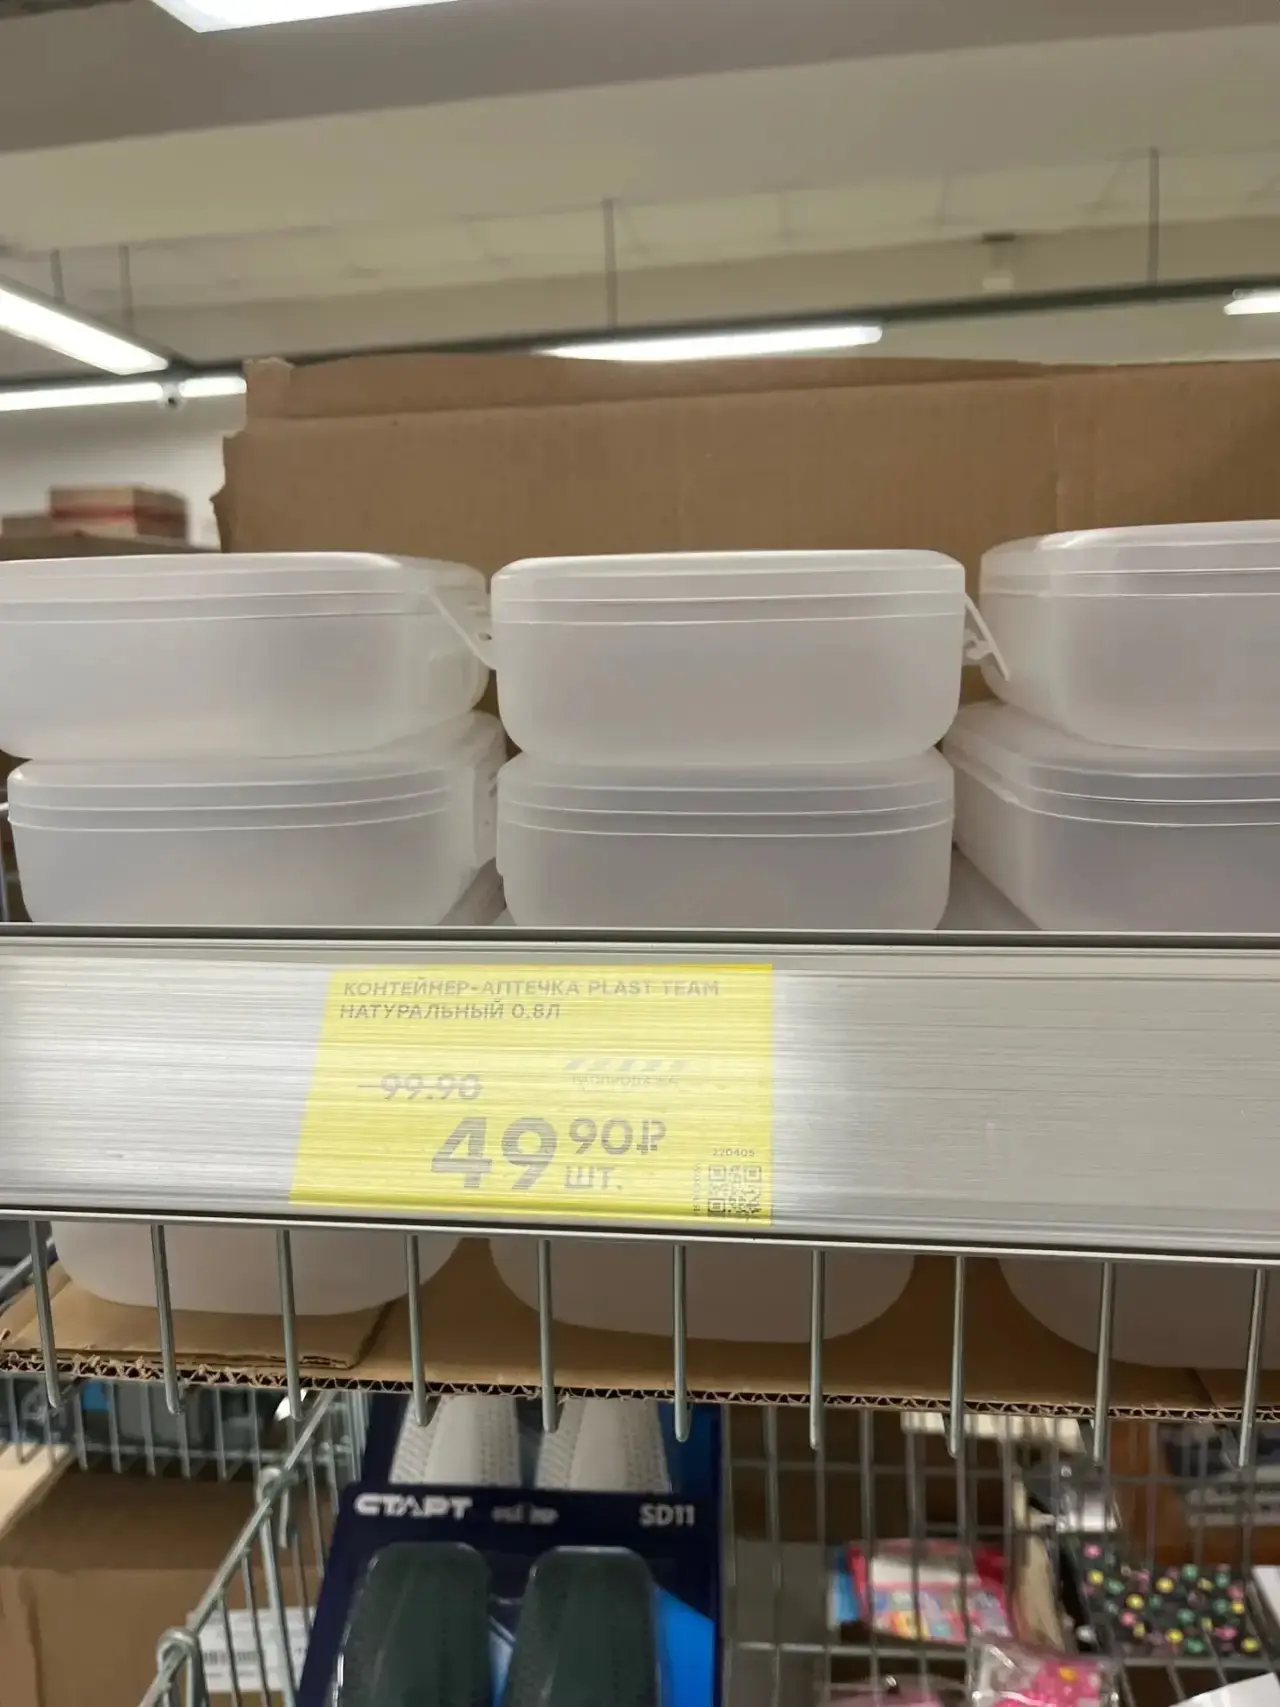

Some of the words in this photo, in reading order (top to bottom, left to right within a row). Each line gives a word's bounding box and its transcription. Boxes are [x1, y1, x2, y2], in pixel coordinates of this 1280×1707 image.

[344, 976, 580, 996] КОНТЕЙНЕР-АПТЕЧКА
[588, 979, 653, 996] PLAST
[662, 980, 720, 997] TEAM
[340, 998, 504, 1019] НАТУРАЛЬНЫЙ
[511, 1003, 560, 1020] 0.8Л
[380, 1073, 483, 1100] 99.90
[431, 1116, 558, 1190] 49
[712, 1148, 755, 1158] 220405
[638, 1503, 696, 1527] SD11
